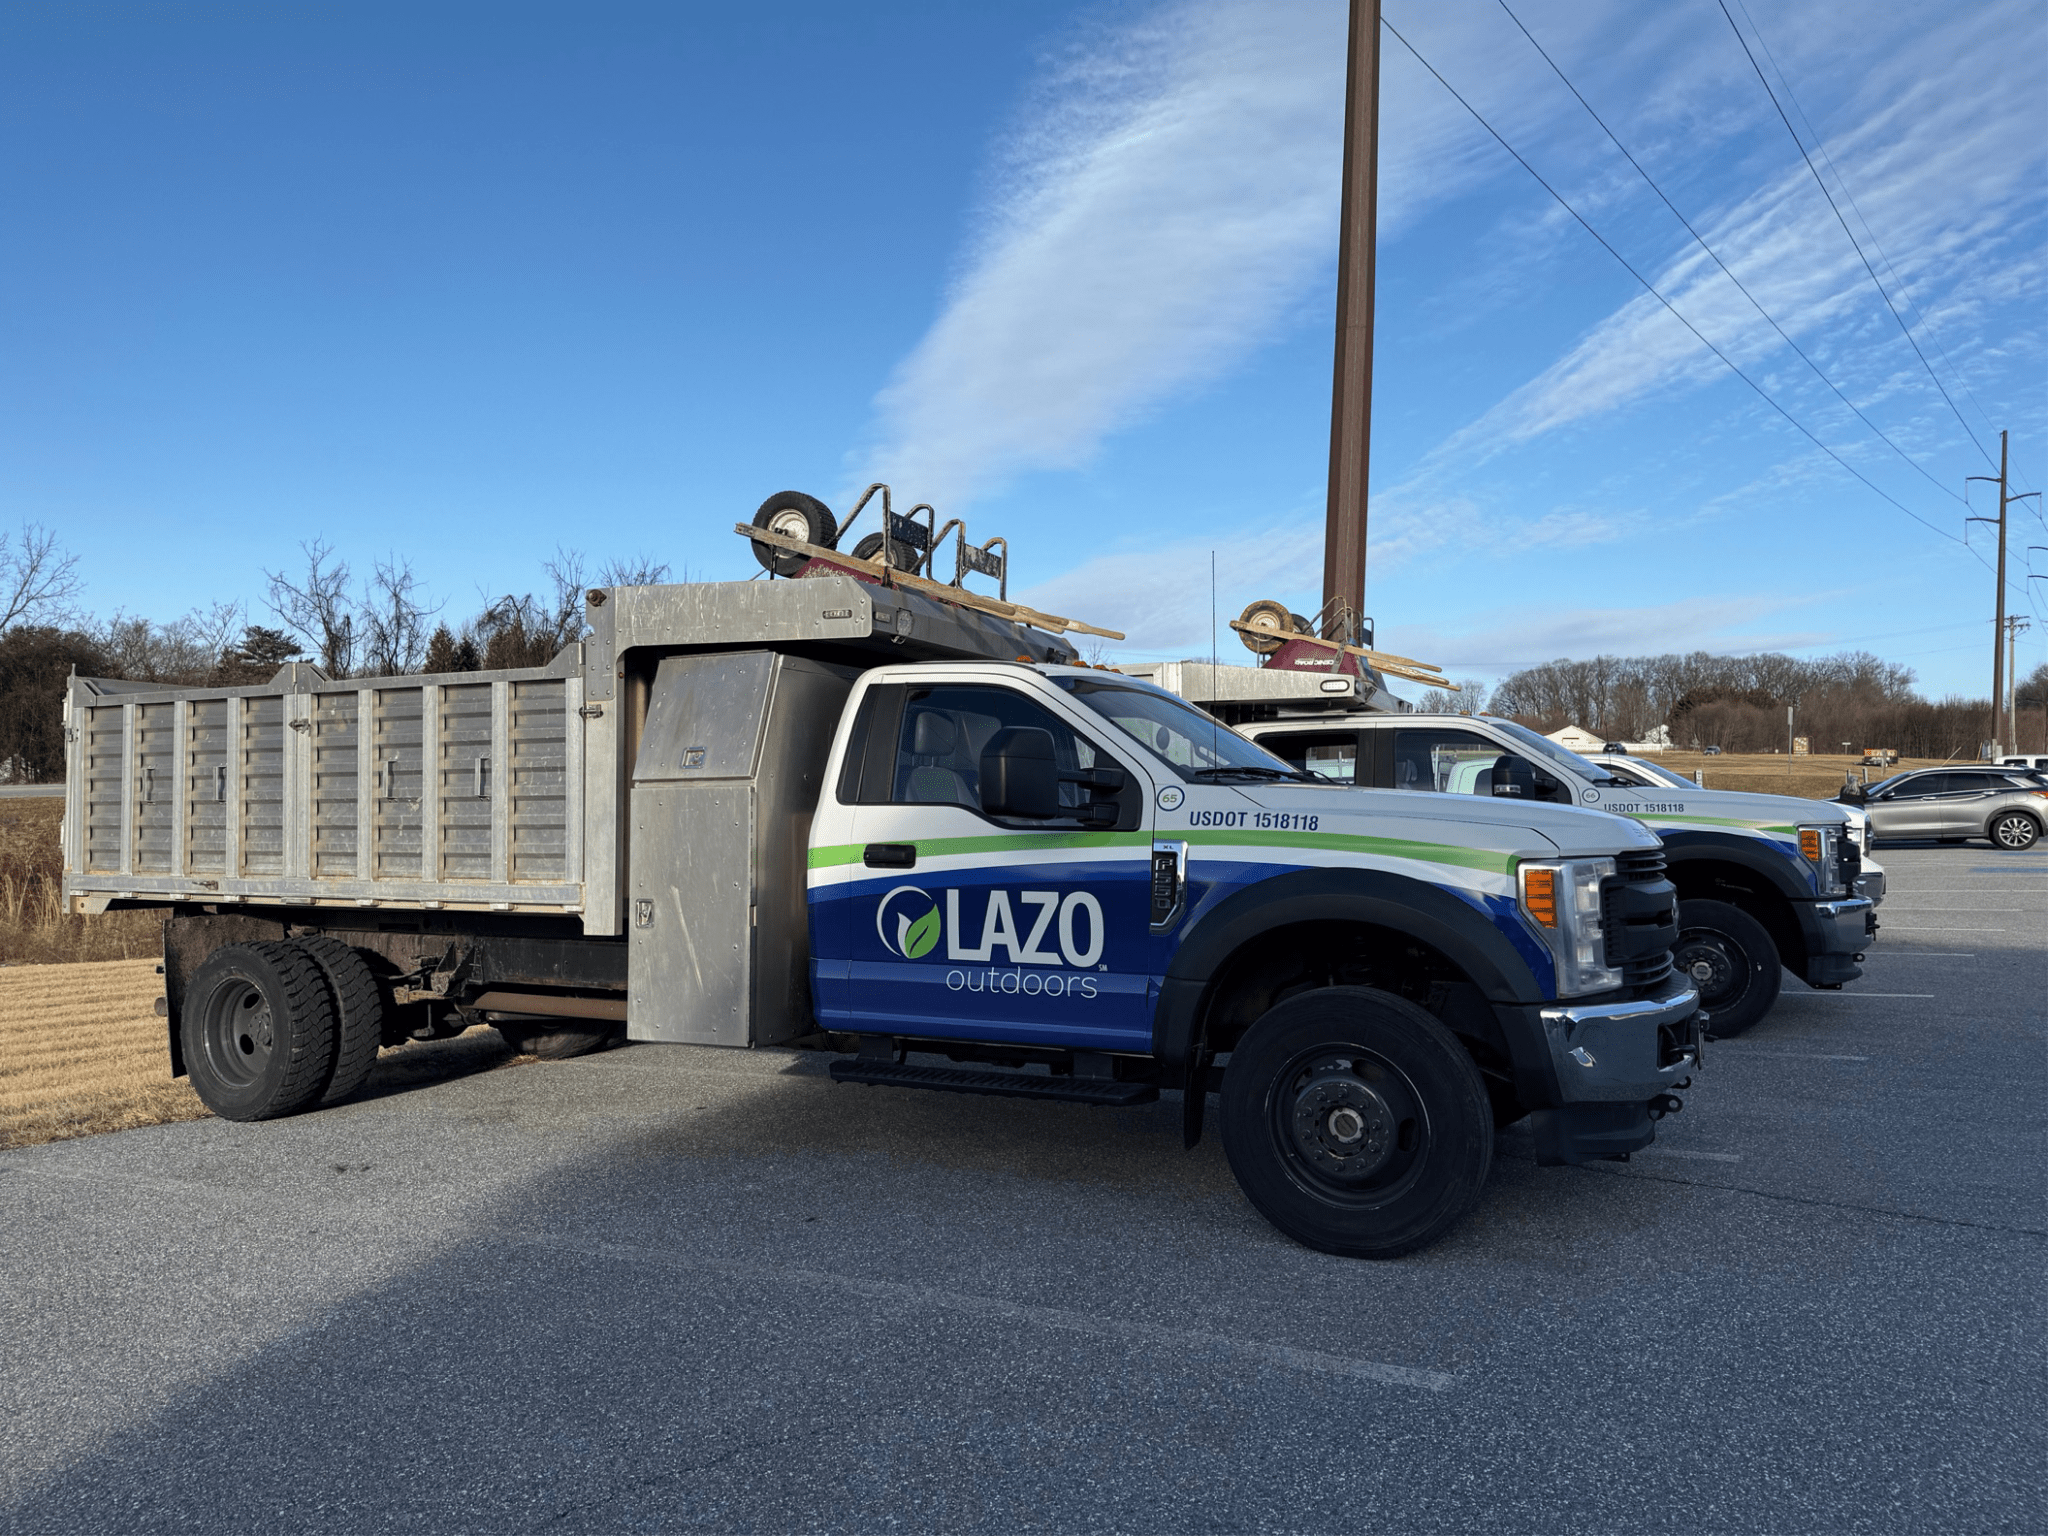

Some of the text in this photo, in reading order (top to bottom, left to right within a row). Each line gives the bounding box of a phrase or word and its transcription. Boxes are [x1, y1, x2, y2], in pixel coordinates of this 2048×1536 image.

[1162, 794, 1178, 803] 65
[1604, 803, 1685, 813] USDOT 1518118
[1189, 811, 1319, 831] USDOT 1518118
[946, 888, 1104, 968] LAZO
[946, 966, 1098, 999] outdoors
